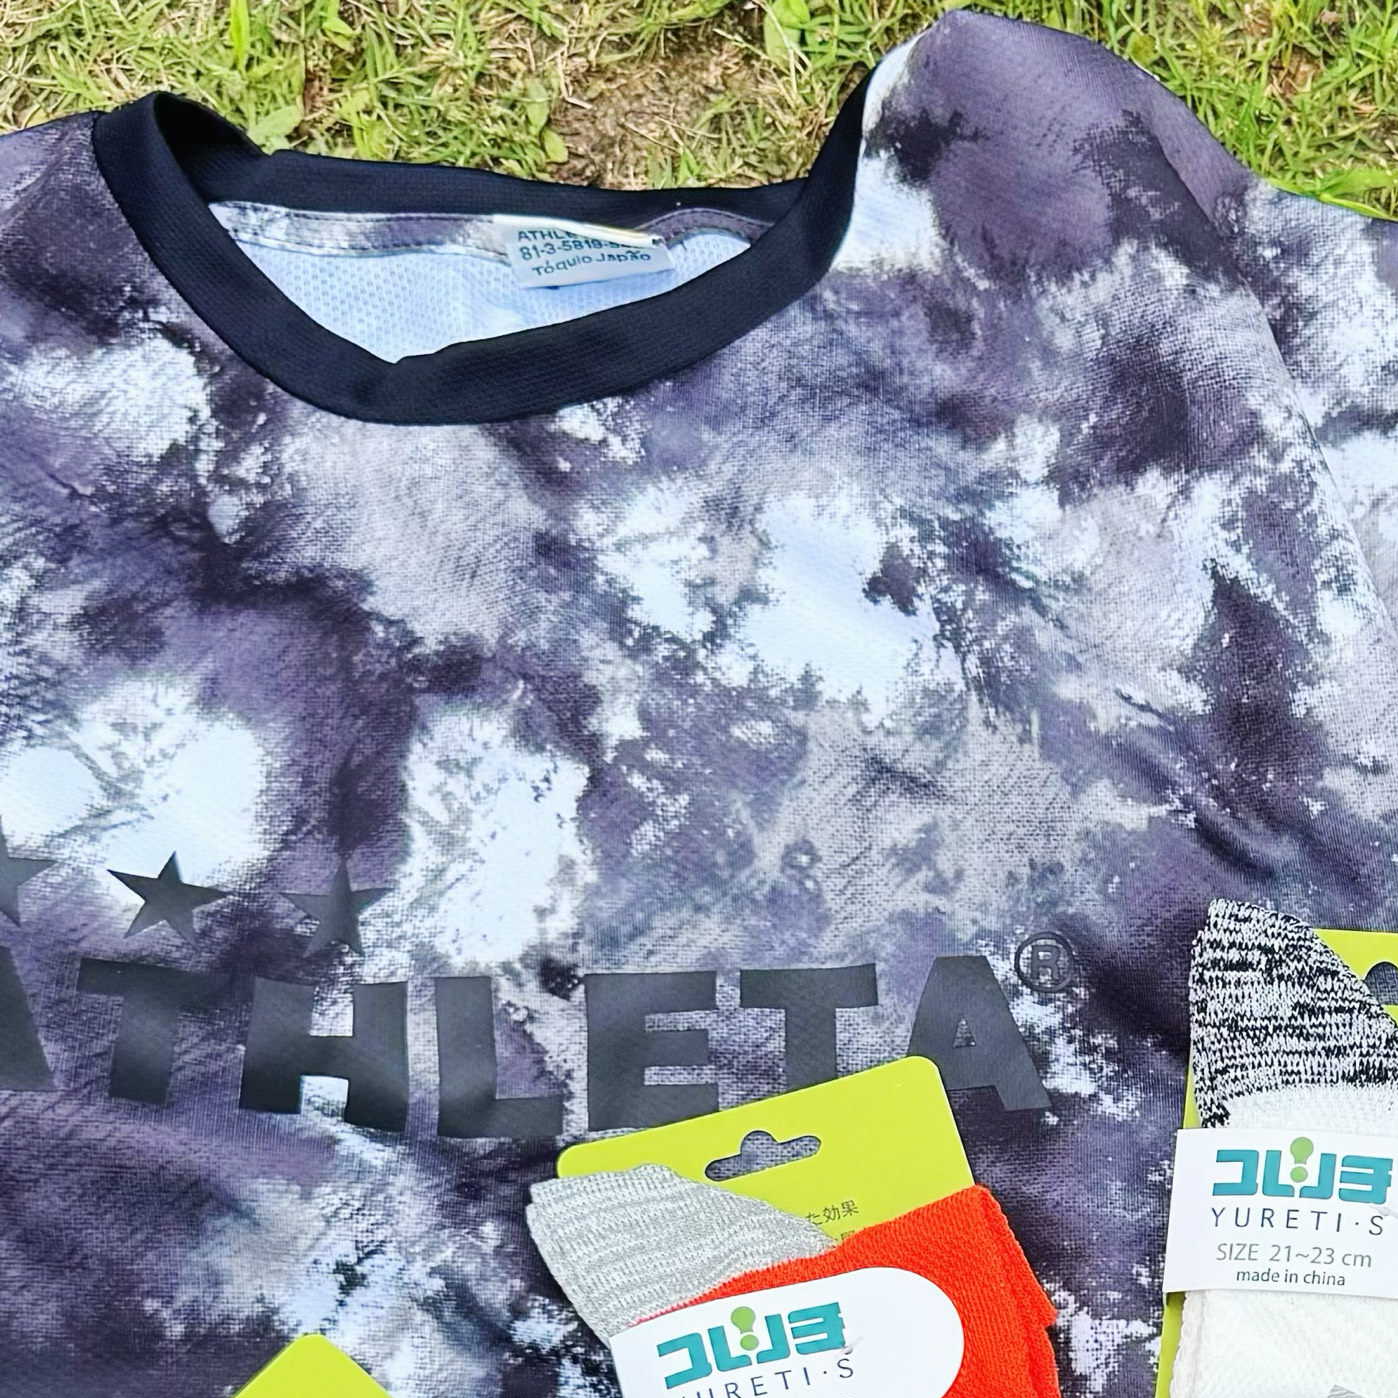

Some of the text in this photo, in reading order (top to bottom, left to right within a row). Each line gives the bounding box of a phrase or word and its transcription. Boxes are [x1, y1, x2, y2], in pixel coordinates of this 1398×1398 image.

[1217, 1242, 1372, 1268] SIZE 21~23 cm
[1236, 1267, 1346, 1287] made in china
